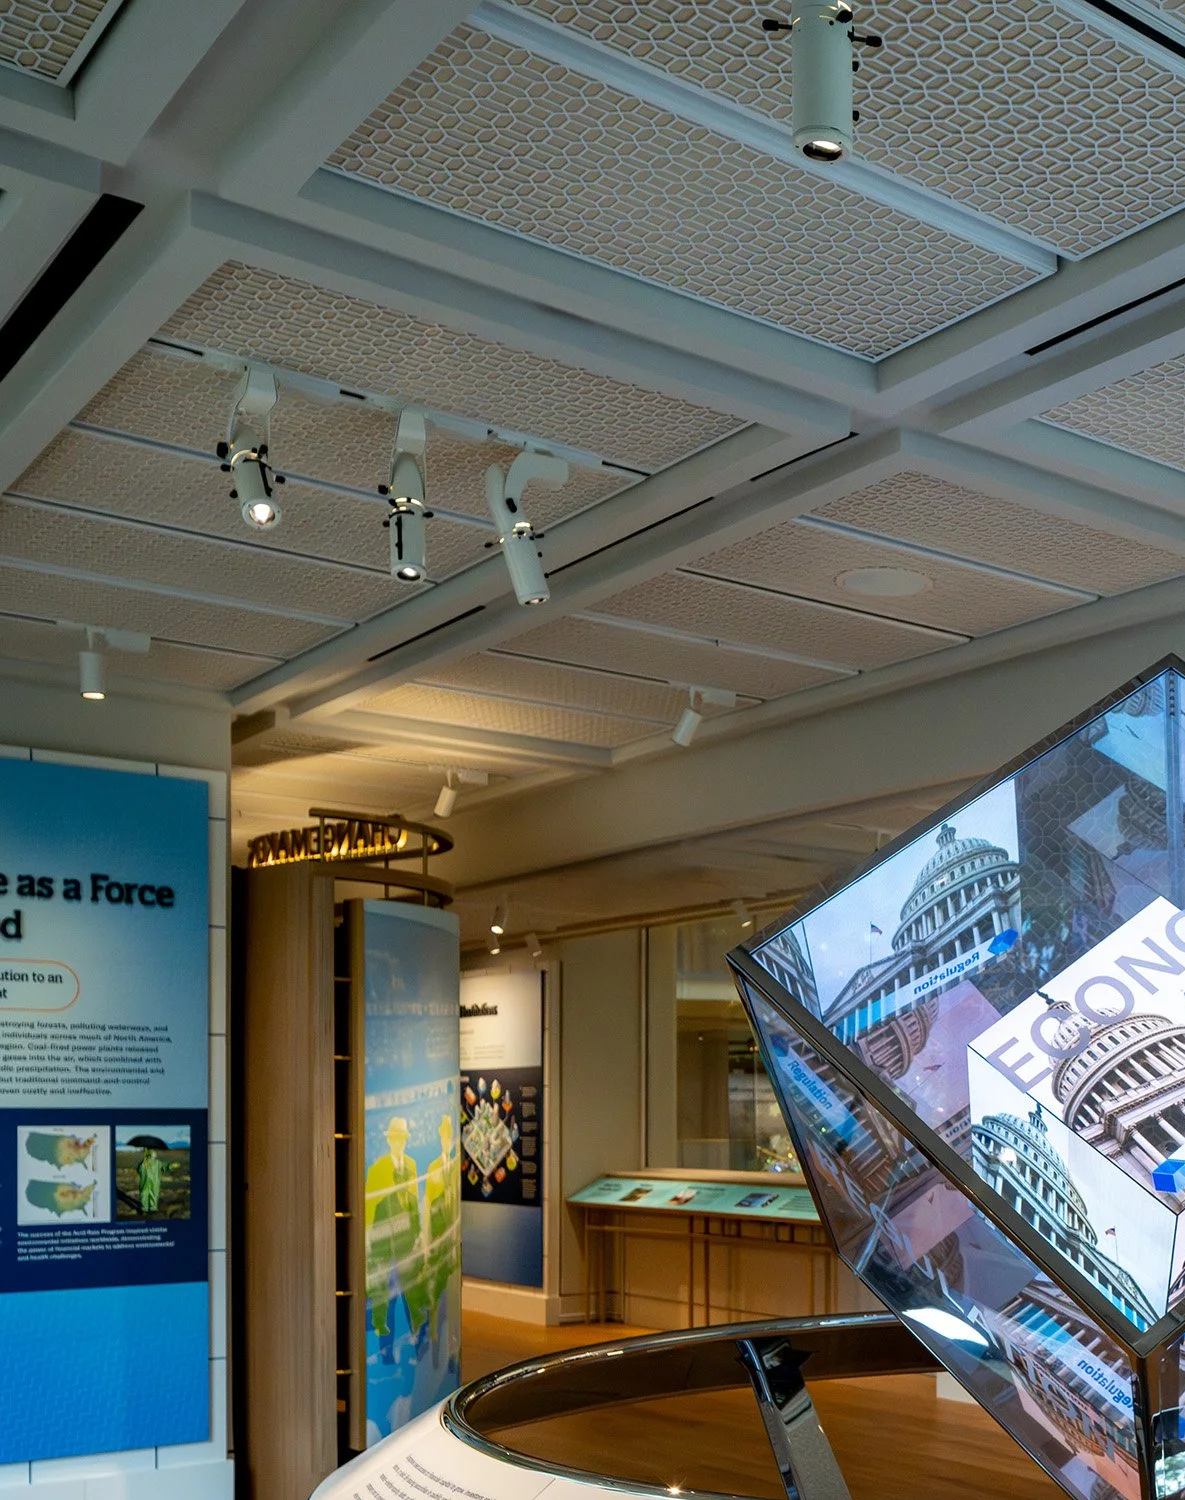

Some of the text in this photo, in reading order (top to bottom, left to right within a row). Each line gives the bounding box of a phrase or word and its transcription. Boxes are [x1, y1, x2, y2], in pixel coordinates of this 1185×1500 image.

[16, 874, 55, 899] as
[62, 877, 82, 901] a
[90, 873, 175, 907] Force
[32, 971, 45, 983] to
[47, 973, 63, 984] an
[787, 1059, 833, 1110] Regulation
